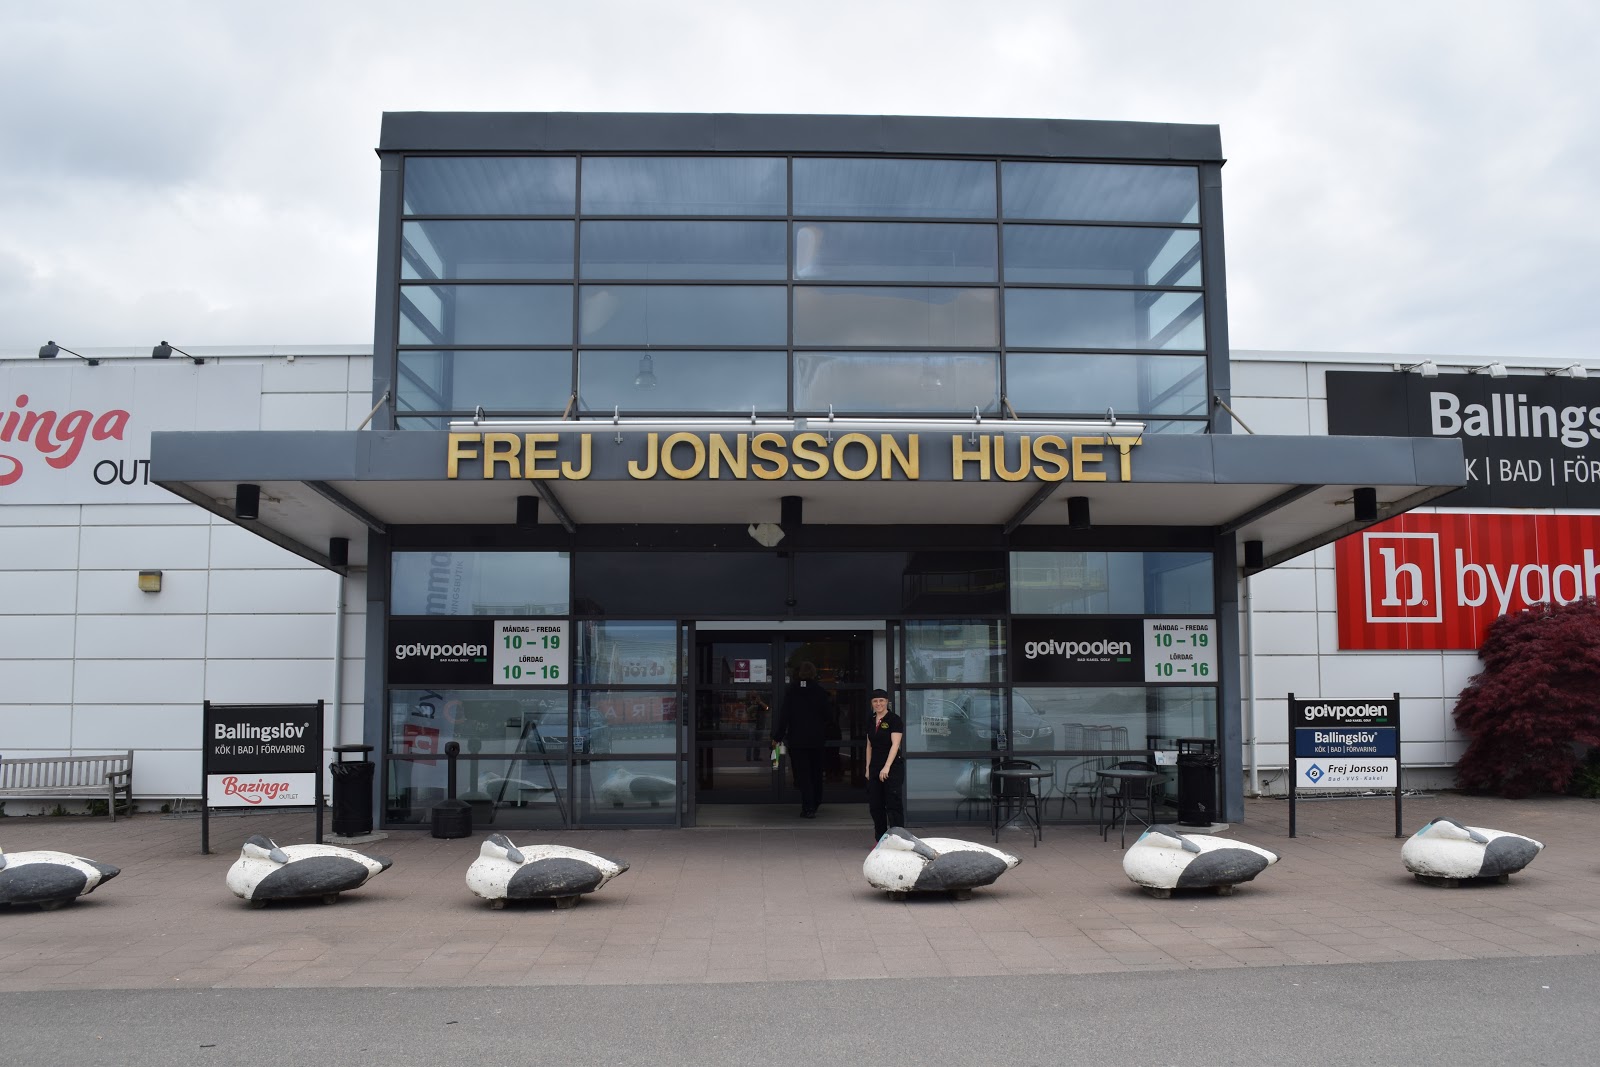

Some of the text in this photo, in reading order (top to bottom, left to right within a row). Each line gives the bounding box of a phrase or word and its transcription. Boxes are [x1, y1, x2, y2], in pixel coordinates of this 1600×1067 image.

[0, 394, 130, 469] inga
[447, 432, 1143, 482] FREJ JONSSON HUSET
[1500, 460, 1542, 482] BAD
[1153, 623, 1179, 631] MÅNDAG
[503, 635, 522, 649] 10
[541, 635, 561, 649] 19
[1154, 633, 1173, 647] 10
[1190, 633, 1208, 647] 19
[503, 665, 522, 679] 10
[541, 665, 559, 679] 16
[1154, 662, 1173, 677] 10
[1190, 662, 1209, 677] 16
[215, 744, 231, 755] KÖK
[237, 745, 254, 754] BAD
[260, 743, 305, 754] FÖRVARING
[1346, 745, 1377, 753] FÖRVARING
[1328, 764, 1389, 775] Frej Jonsson
[221, 776, 290, 804] Bazinga
